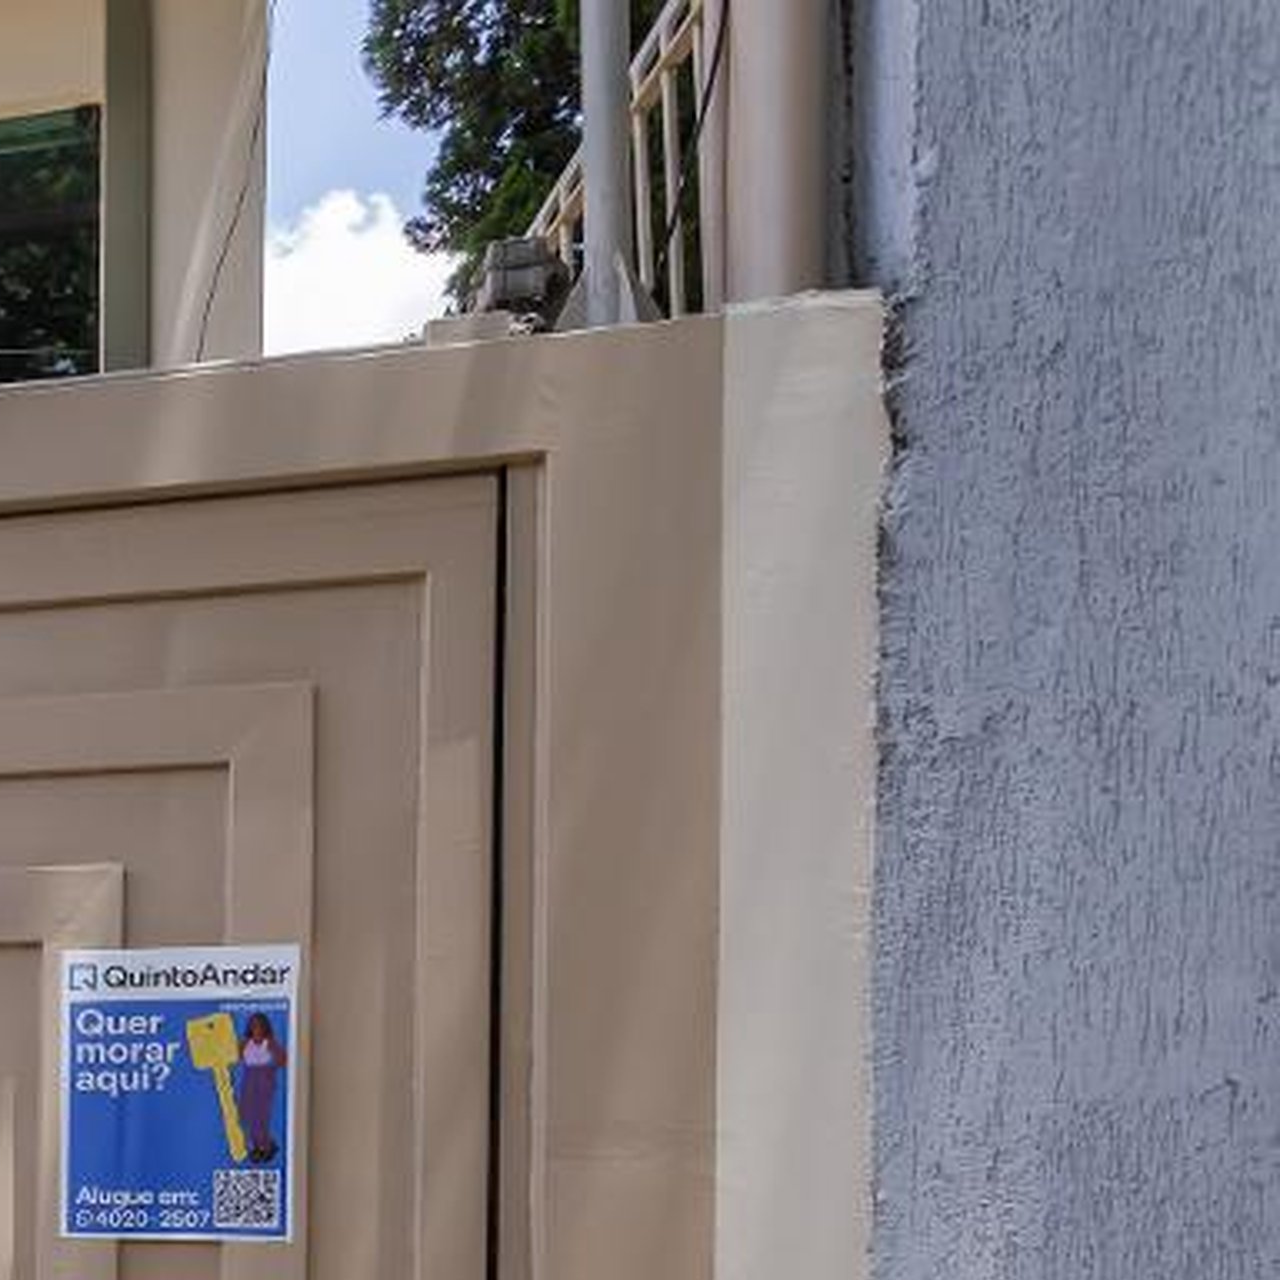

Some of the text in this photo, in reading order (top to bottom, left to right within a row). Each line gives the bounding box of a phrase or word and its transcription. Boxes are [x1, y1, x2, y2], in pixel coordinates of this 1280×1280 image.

[104, 964, 291, 988] QuintoAndar
[75, 1009, 163, 1036] Quer
[75, 1042, 180, 1064] morar
[75, 1064, 171, 1097] aqui?
[75, 1186, 154, 1210] Alugue
